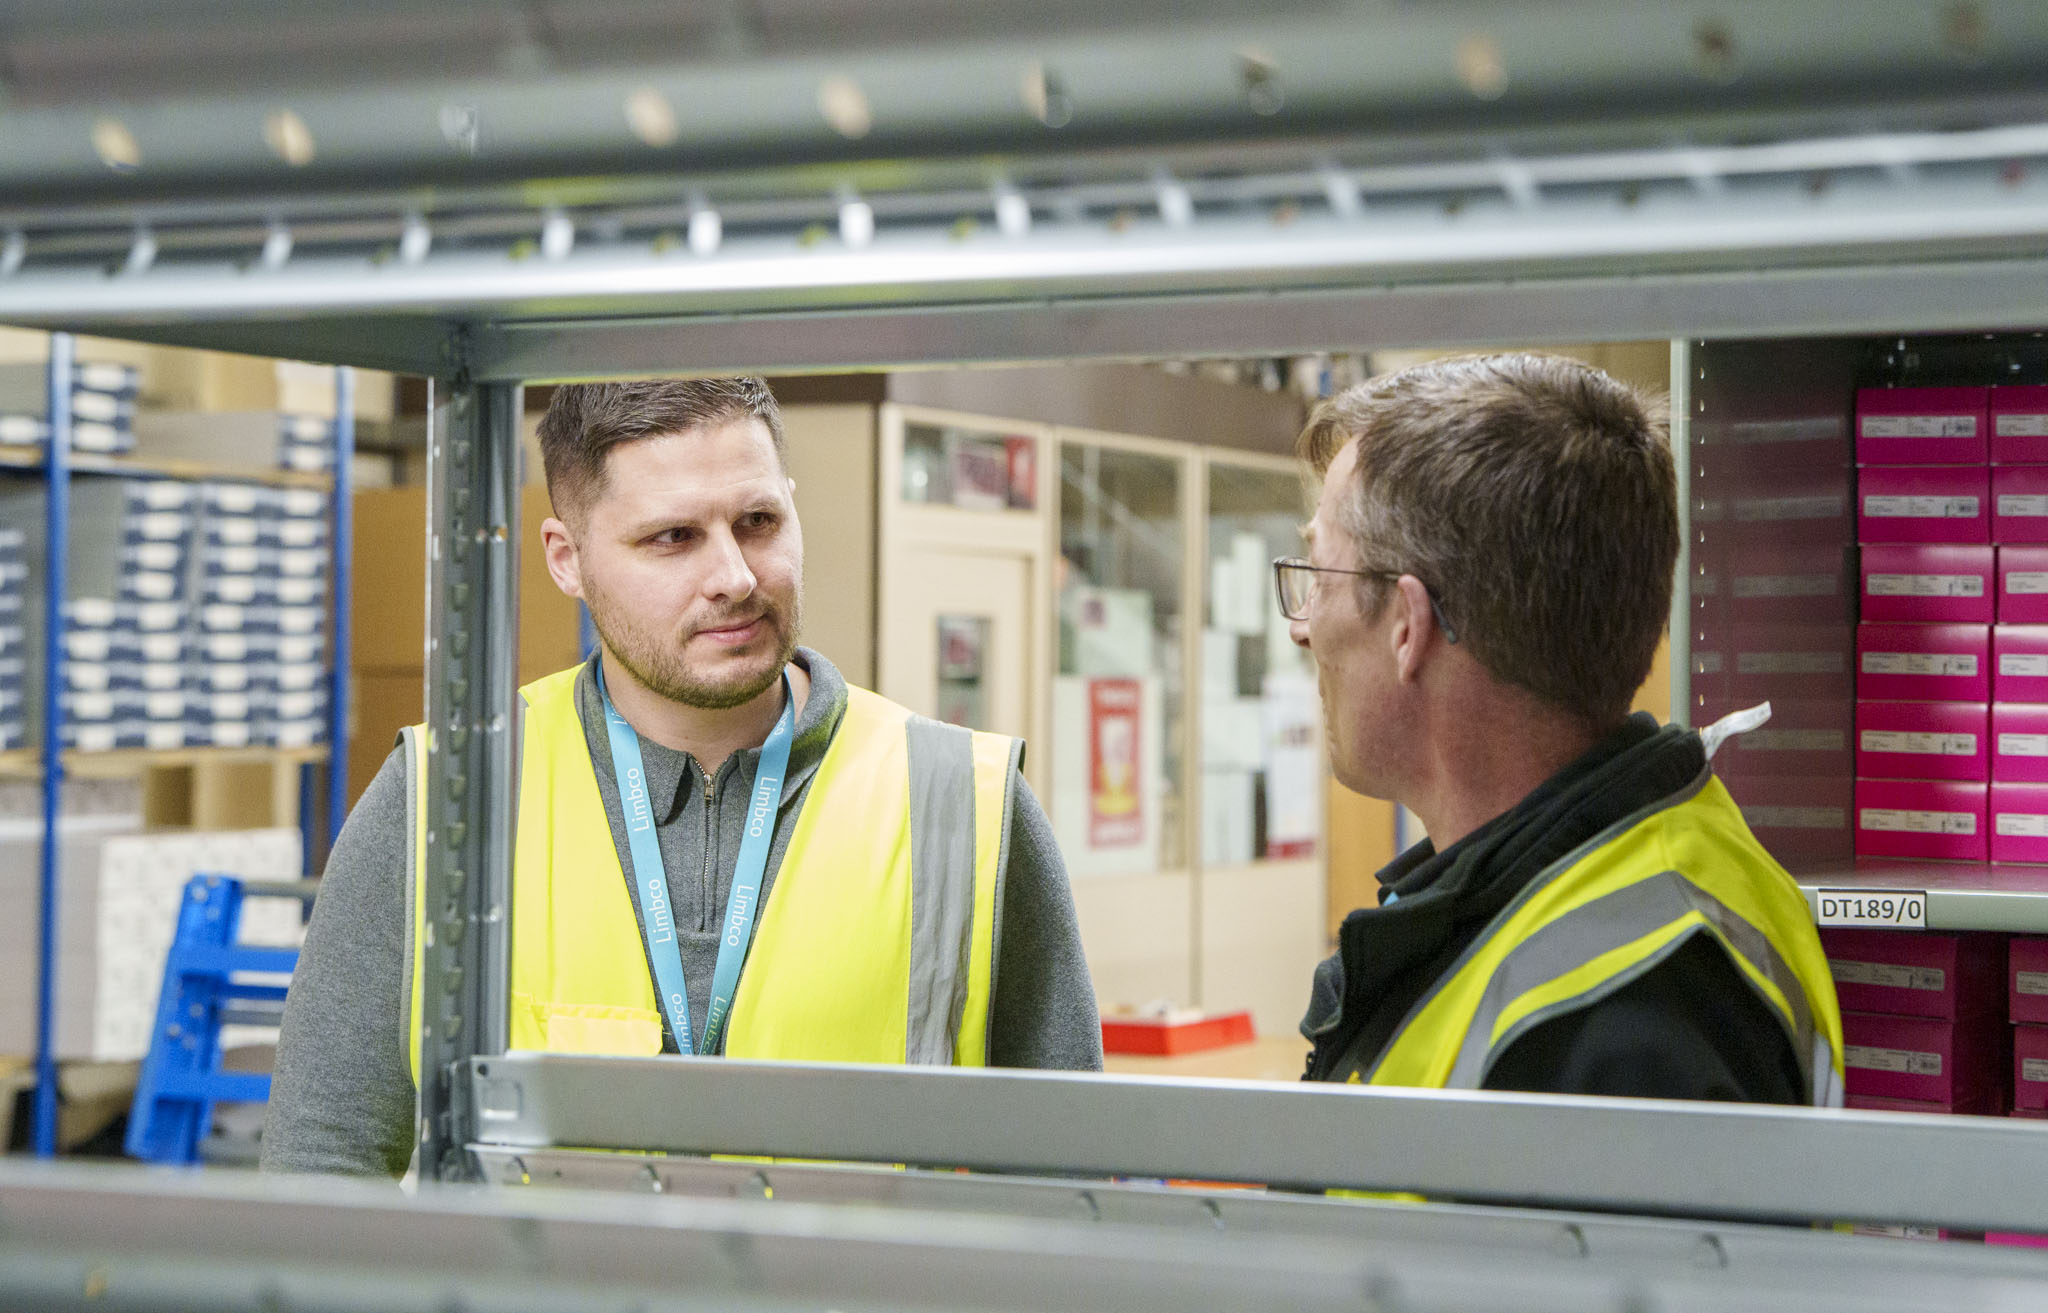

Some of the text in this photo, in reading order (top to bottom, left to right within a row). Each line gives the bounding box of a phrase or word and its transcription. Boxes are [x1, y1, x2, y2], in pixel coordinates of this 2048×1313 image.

[627, 768, 649, 832] Limbco
[751, 776, 778, 838] Limbco
[649, 879, 671, 944] Limbco
[728, 885, 755, 947] Limbco
[1822, 898, 1921, 922] DT189/0
